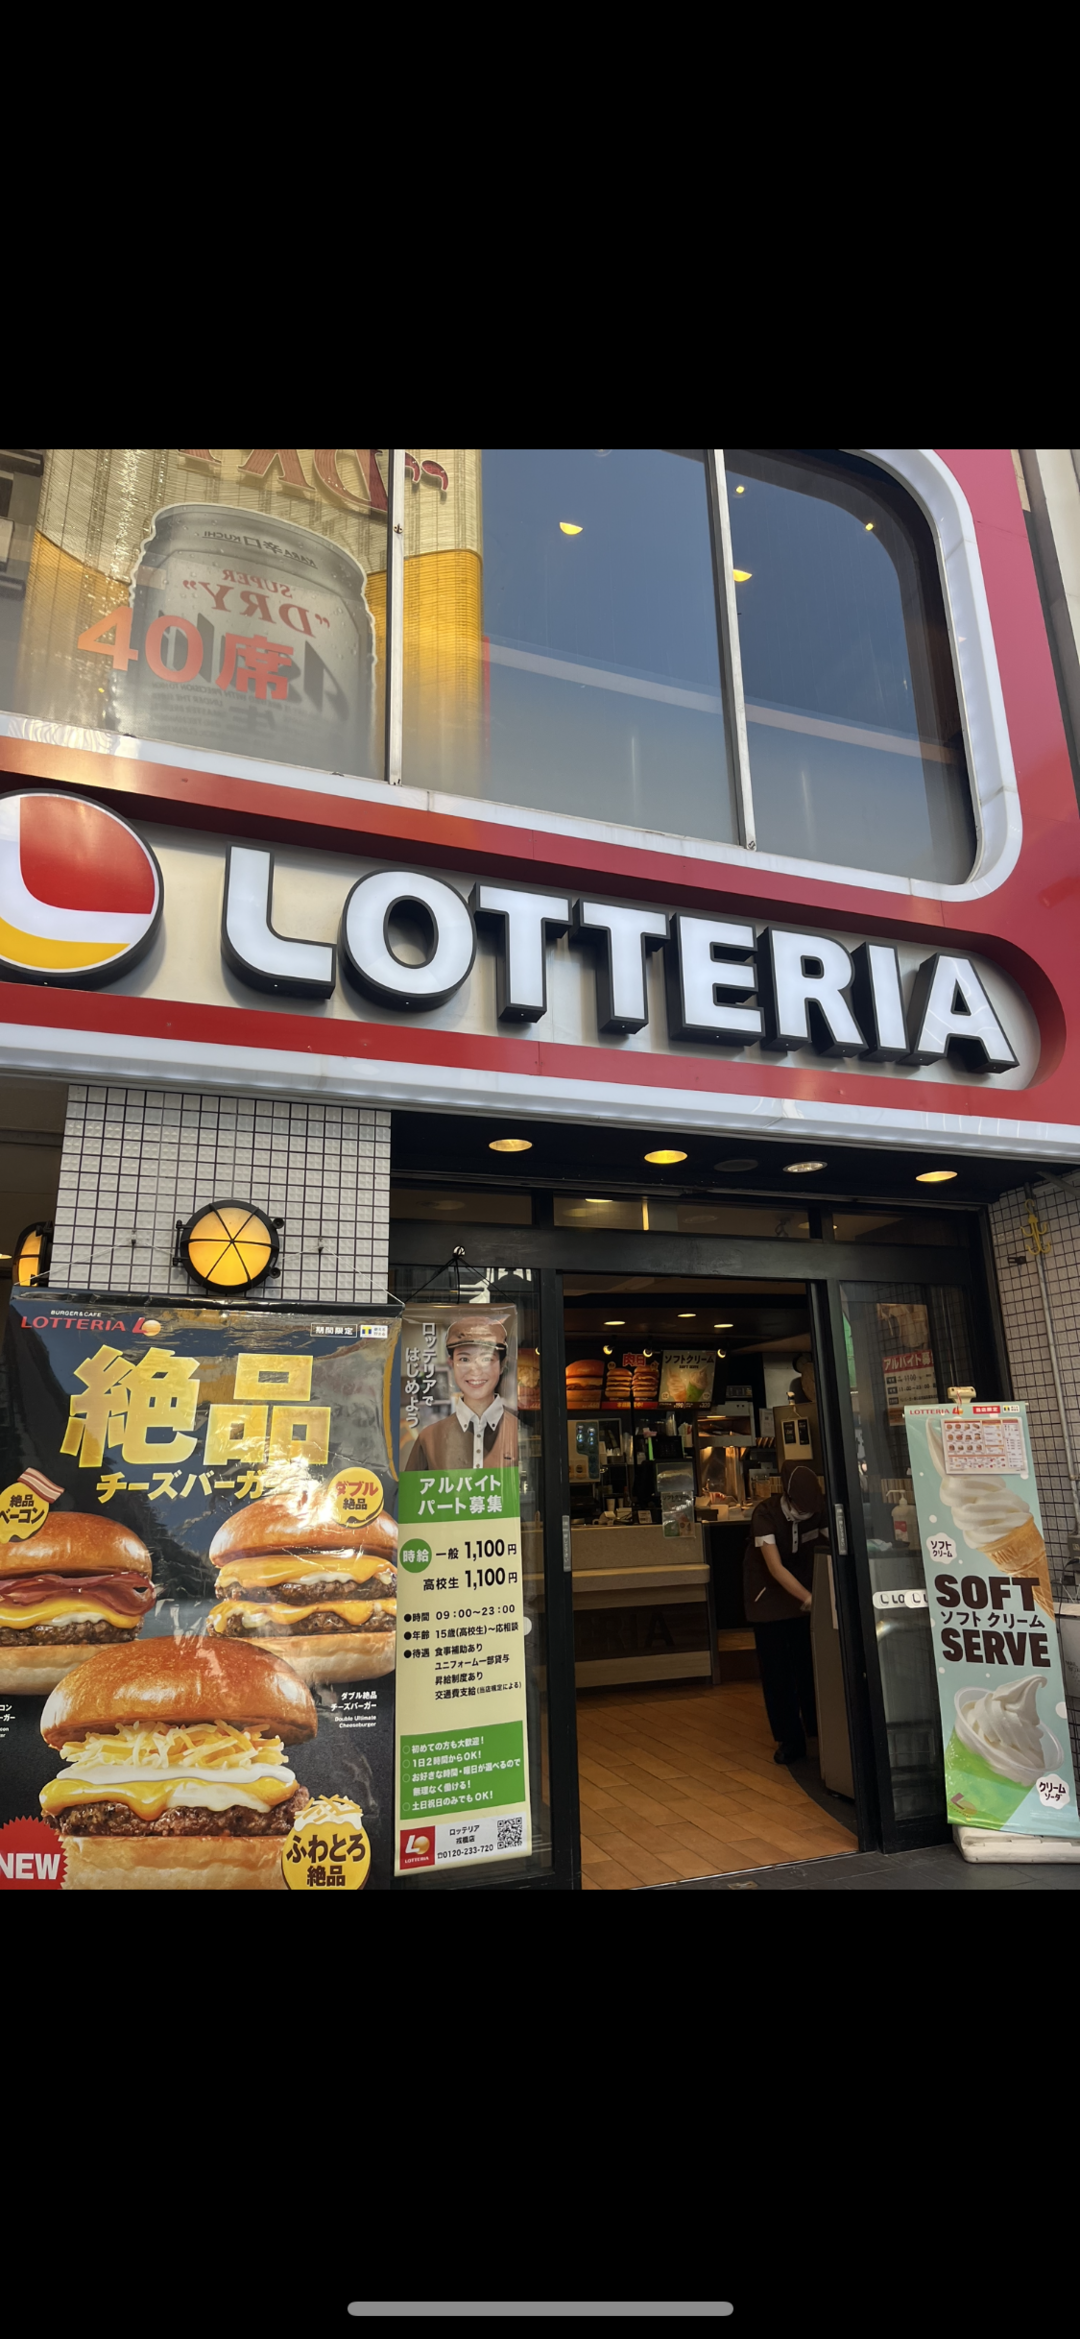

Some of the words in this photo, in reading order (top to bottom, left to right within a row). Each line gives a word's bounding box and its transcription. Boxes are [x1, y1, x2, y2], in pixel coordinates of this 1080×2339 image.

[220, 844, 1020, 1075] LOTTERIA
[21, 1315, 126, 1332] LOTTERIA
[315, 1326, 354, 1336] 期間限定
[422, 1322, 437, 1407] ロッテリアで
[664, 1354, 714, 1364] ソフトクリーム
[884, 1352, 934, 1371] アルバイト募
[405, 1346, 420, 1429] はじめよう
[60, 1344, 331, 1468] 絶品
[336, 1481, 379, 1497] ダブル
[420, 1474, 501, 1495] アルバイト
[9, 1494, 34, 1508] 絶品
[342, 1498, 368, 1511] 絶品
[418, 1494, 502, 1515] パート募集
[0, 1507, 45, 1525] ベーコン
[931, 1541, 952, 1550] ソフト
[402, 1549, 430, 1563] 時給
[435, 1547, 459, 1560] 一般
[932, 1550, 953, 1558] クリーム
[423, 1577, 459, 1591] 高校生
[934, 1573, 1040, 1612] SOFT
[412, 1612, 430, 1622] 時間
[941, 1611, 981, 1628] ソフト
[987, 1612, 1046, 1629] クリーム
[412, 1648, 430, 1658] 待遇
[435, 1643, 483, 1657] 食事補助あり
[940, 1627, 1052, 1668] SERVE
[435, 1654, 510, 1671] ユニフォーム一部貸与
[435, 1671, 483, 1686] 昇給制度あり
[341, 1691, 377, 1701] ダブル絶品
[330, 1701, 377, 1711] チーズバーガー
[1039, 1782, 1066, 1794] クリーム
[1045, 1793, 1062, 1802] ソーダ
[449, 1825, 480, 1836] ロッテリア
[286, 1833, 367, 1864] ふわとろ
[0, 1852, 61, 1880] NEW
[306, 1865, 346, 1887] 絶品
